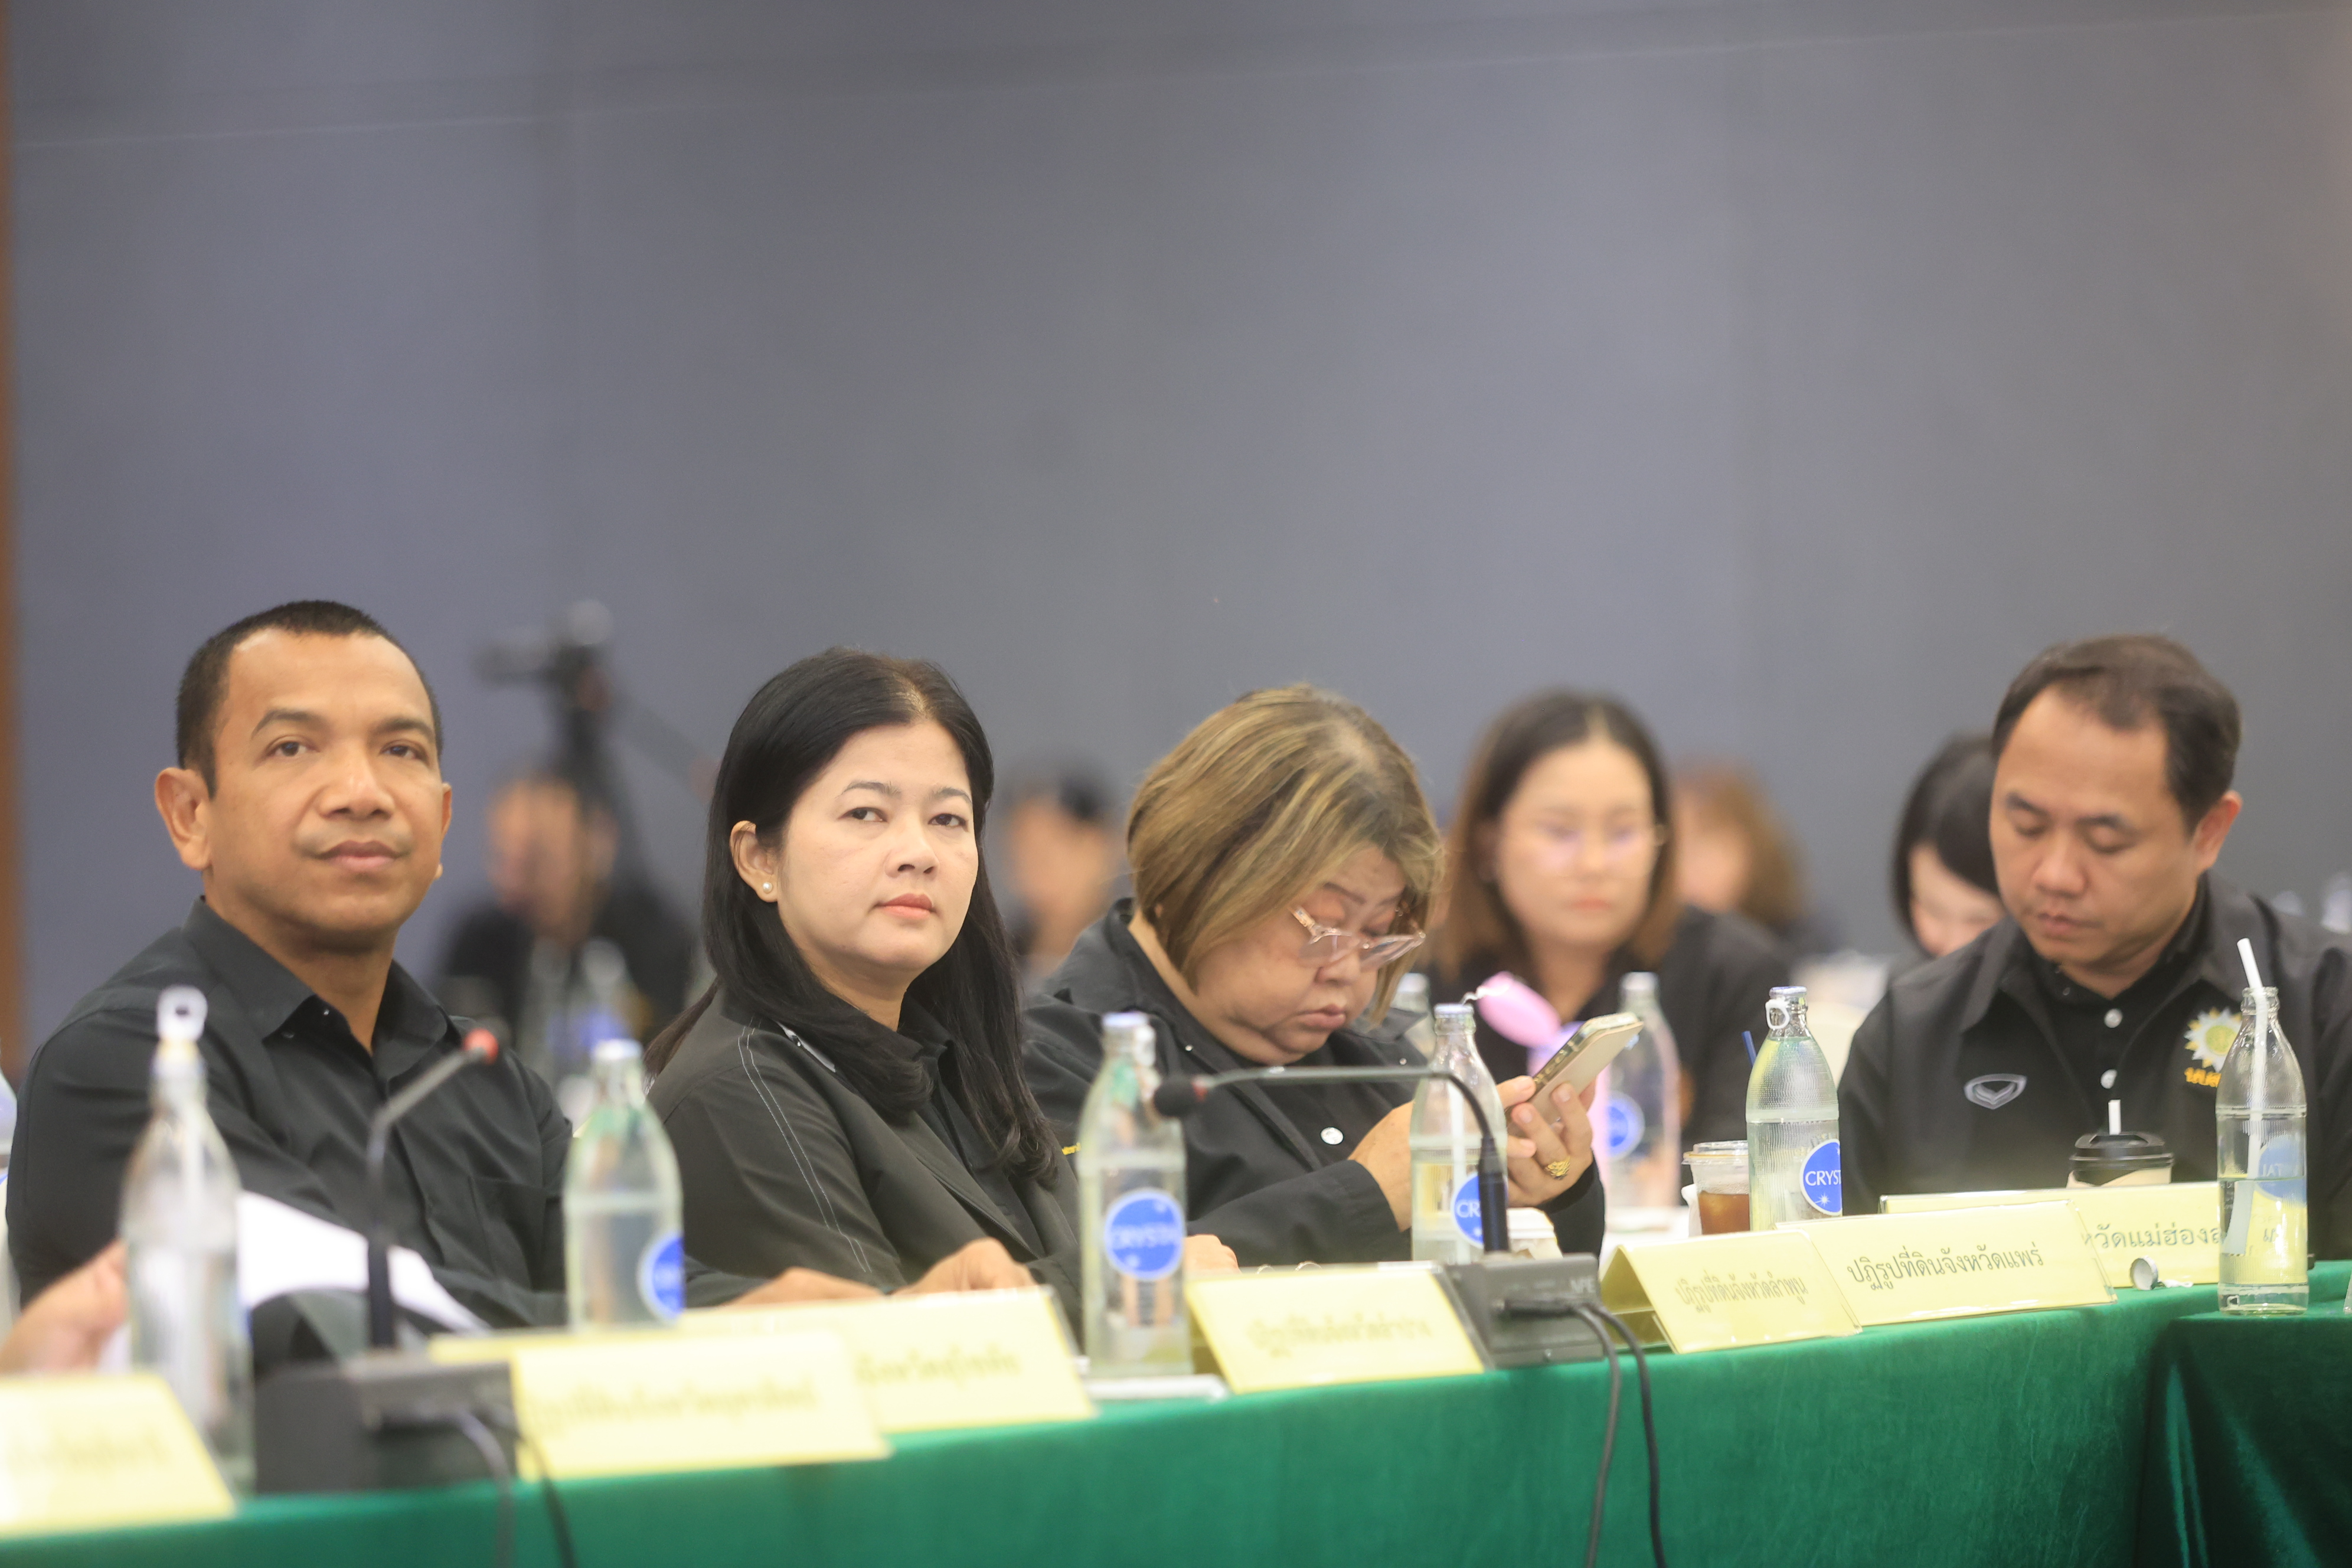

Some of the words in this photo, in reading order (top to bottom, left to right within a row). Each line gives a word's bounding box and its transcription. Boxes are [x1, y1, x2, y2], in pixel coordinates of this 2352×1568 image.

[1847, 1241, 2044, 1291] ปฏิรูปที่ดินจังหวัดแพร่
